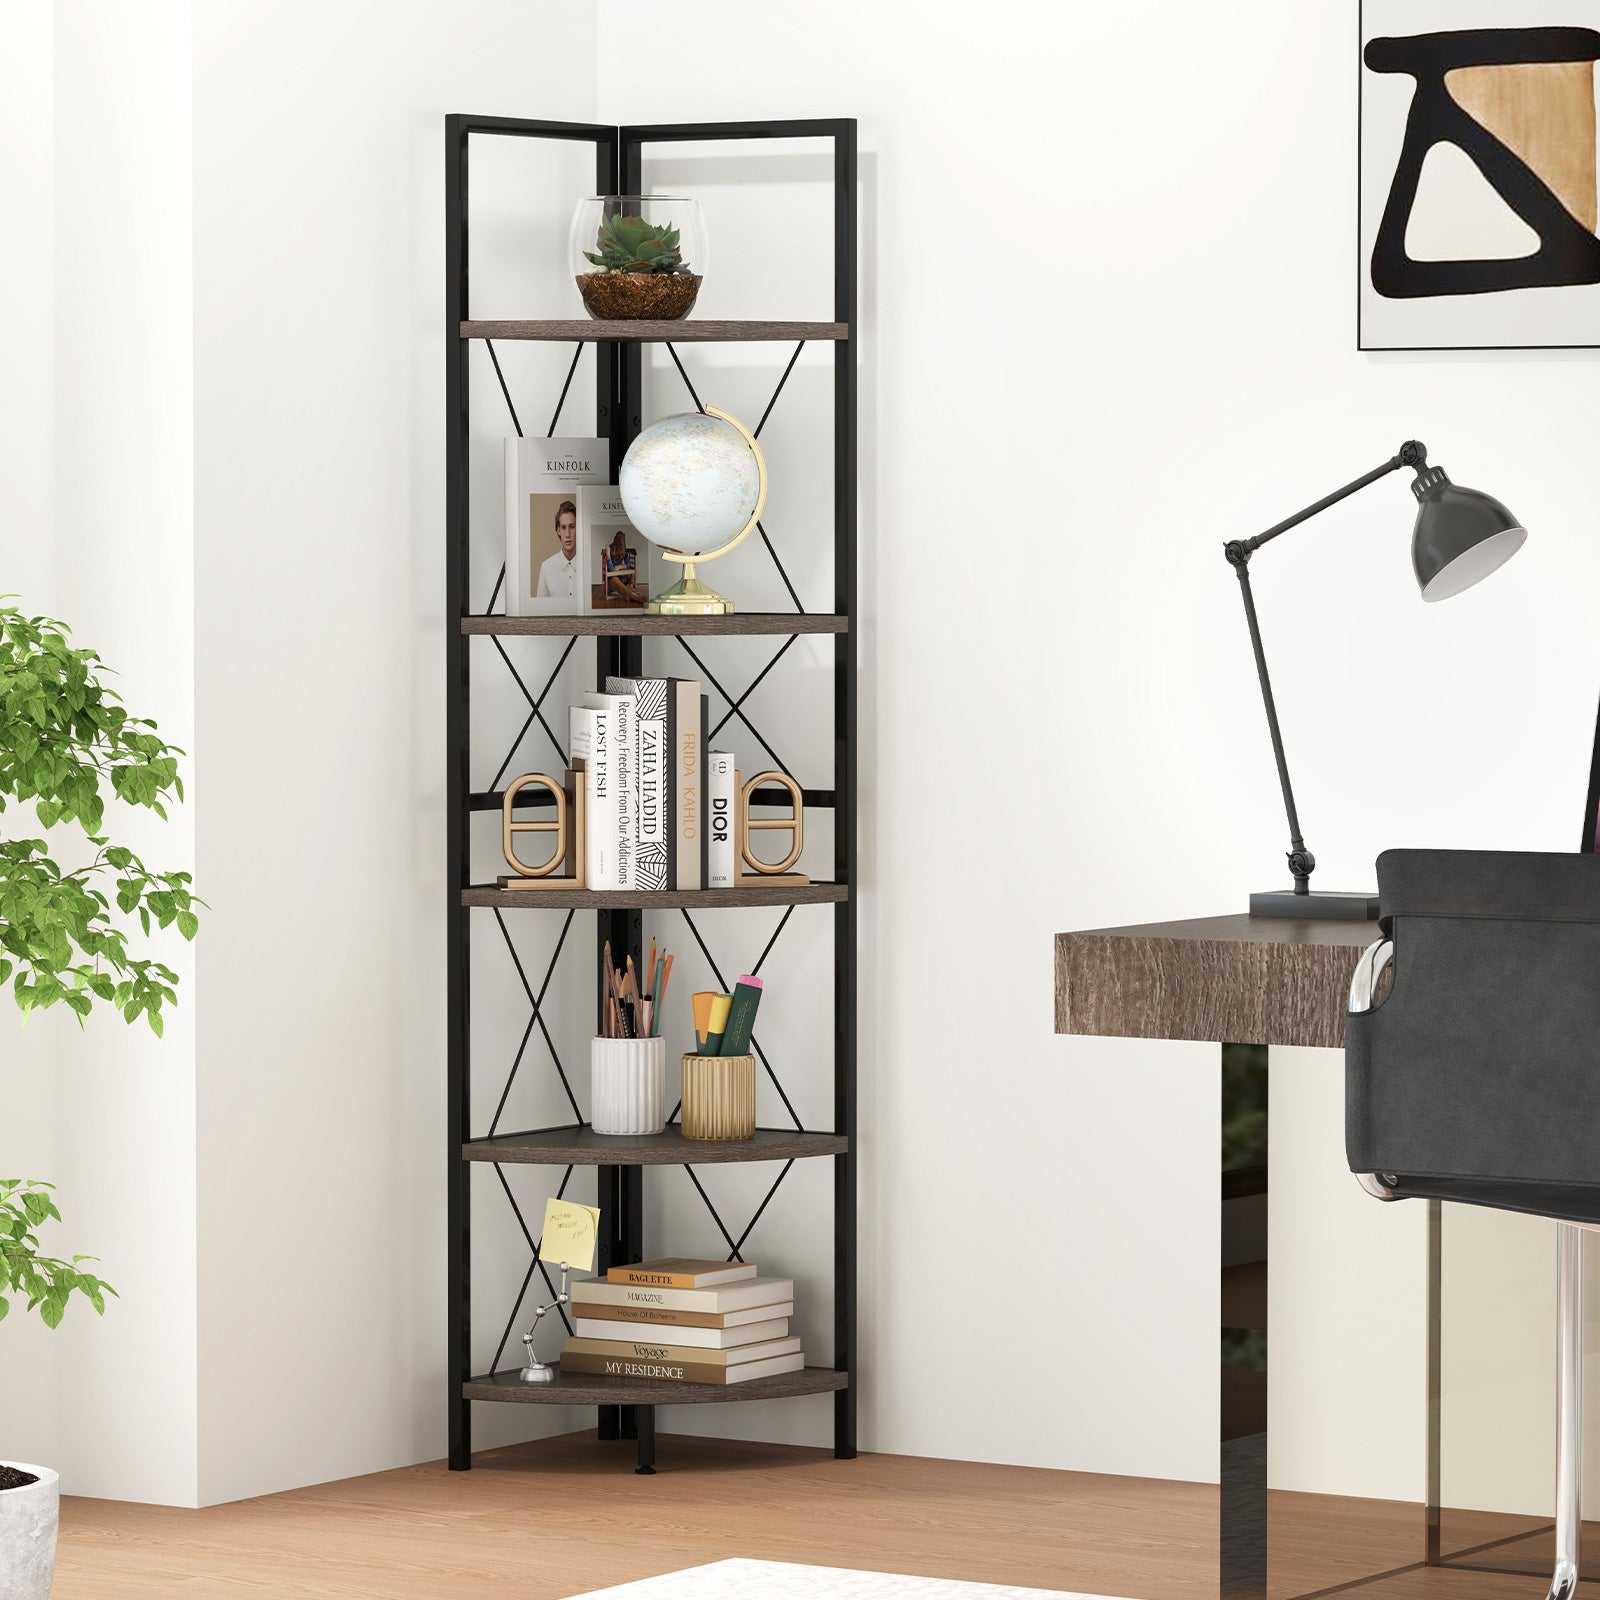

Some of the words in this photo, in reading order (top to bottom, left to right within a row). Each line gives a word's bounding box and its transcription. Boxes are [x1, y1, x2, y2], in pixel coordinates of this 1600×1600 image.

[547, 461, 590, 471] KINFOLK
[597, 715, 606, 756] LOST
[614, 701, 630, 746] Recovery.
[618, 748, 631, 788] Freedom
[643, 731, 657, 776] ZAHA
[683, 733, 696, 777] FRIDA
[597, 762, 606, 798] FISH
[618, 791, 630, 814] From
[643, 780, 657, 834] HADID
[683, 787, 696, 839] KAHLO
[712, 799, 728, 842] DIOR
[618, 816, 630, 834] Our
[618, 836, 631, 885] Addictions
[629, 1273, 673, 1284] BAGUETTE
[618, 1309, 638, 1317] House
[627, 1292, 664, 1304] MAGAZINE
[605, 1361, 623, 1373] MY
[625, 1363, 684, 1379] RESIDENCE
[633, 1344, 669, 1359] Voyage
